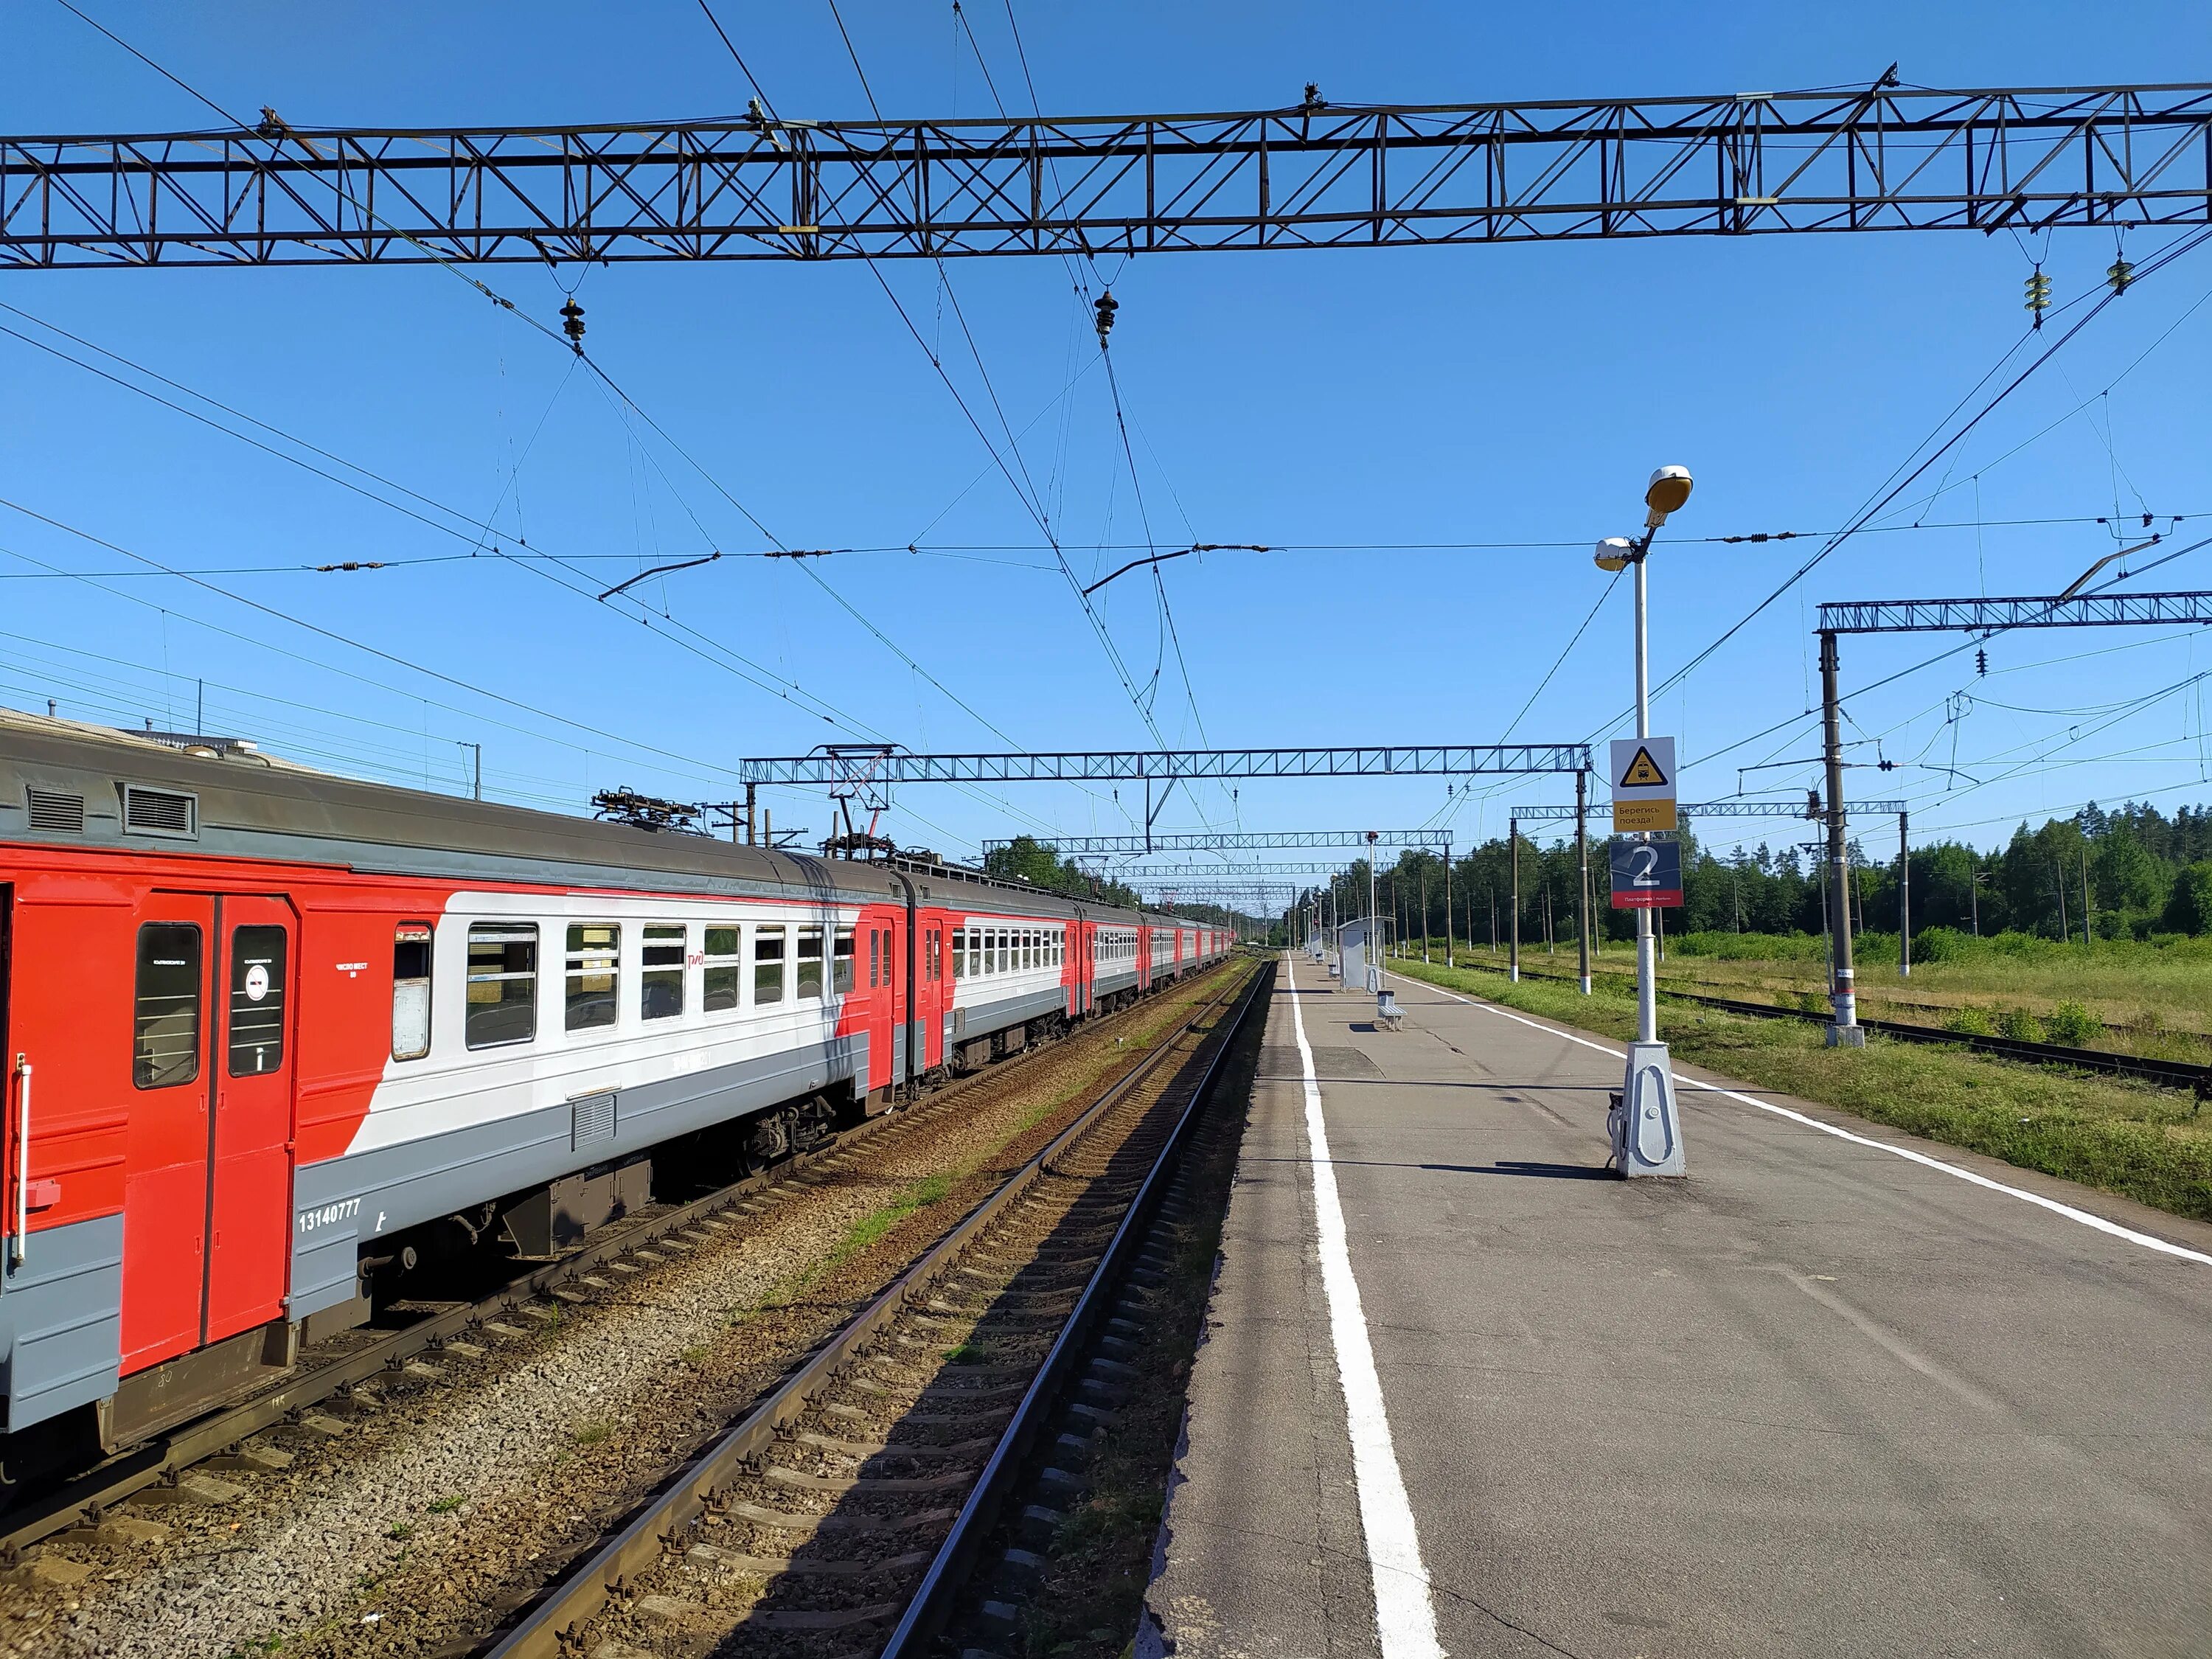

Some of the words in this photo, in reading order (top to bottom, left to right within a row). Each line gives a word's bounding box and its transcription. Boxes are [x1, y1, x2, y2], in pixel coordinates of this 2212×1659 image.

[1619, 807, 1660, 815] Берегись
[1620, 816, 1654, 824] поезда!
[1632, 846, 1660, 886] 2
[299, 1197, 361, 1233] 13140777
[158, 1370, 173, 1387] 80
